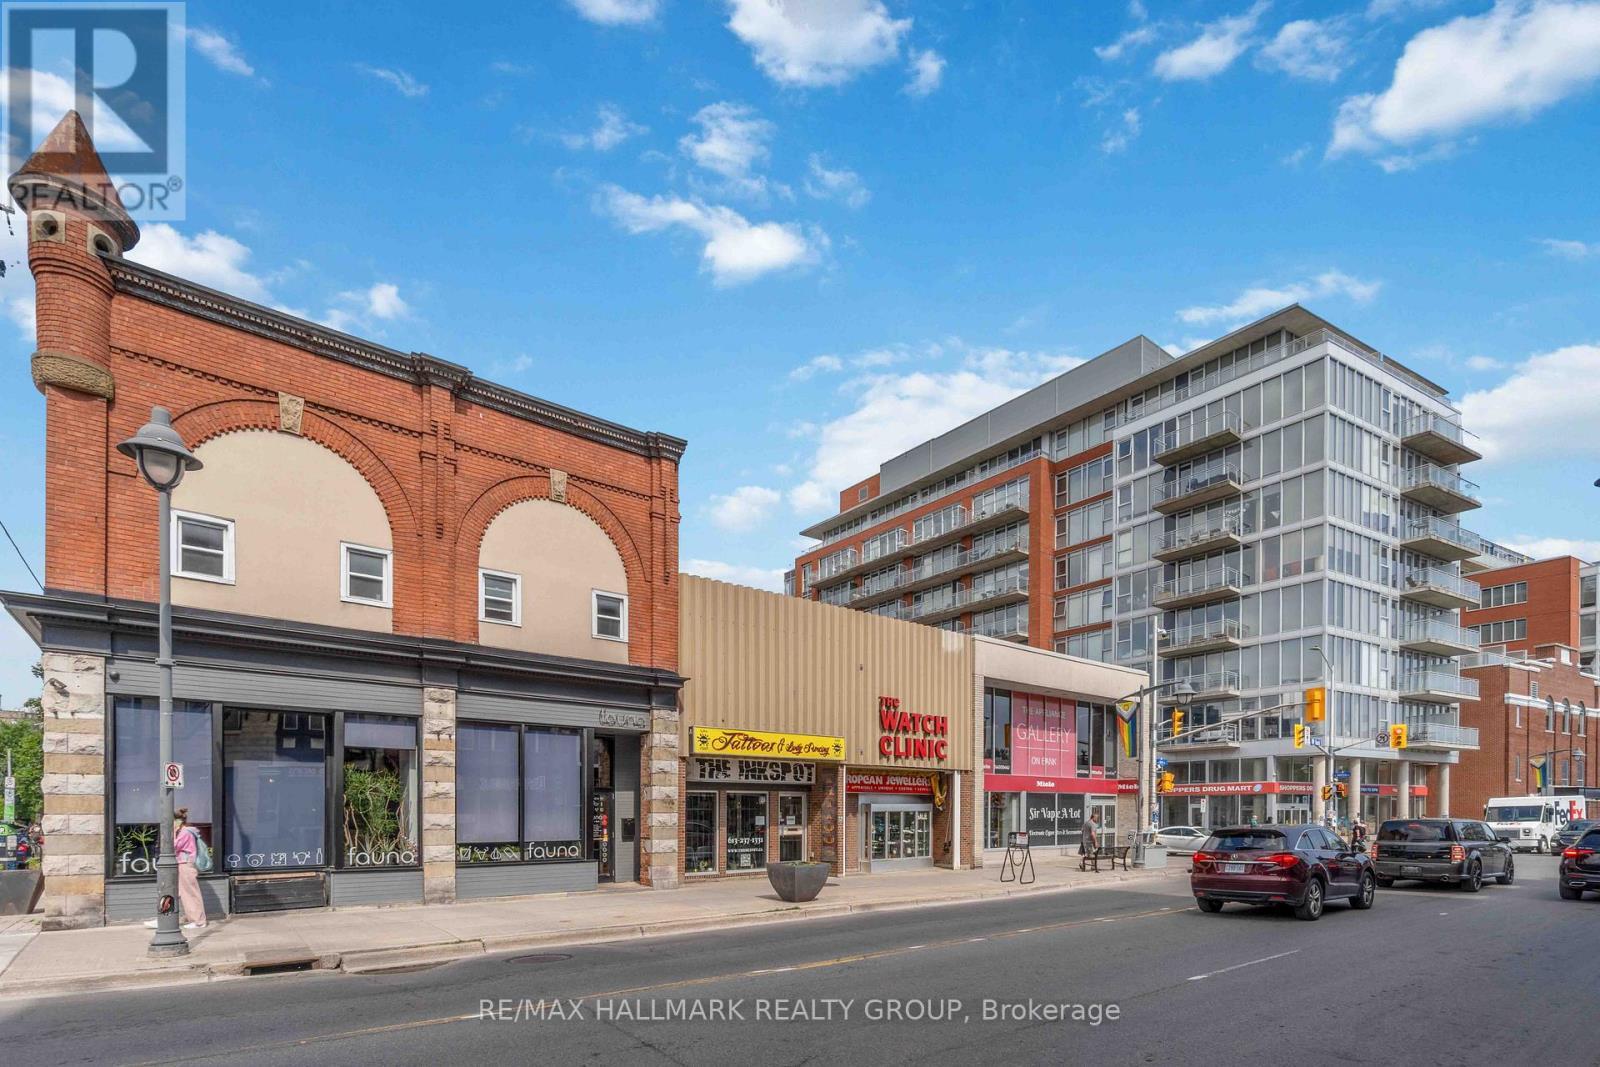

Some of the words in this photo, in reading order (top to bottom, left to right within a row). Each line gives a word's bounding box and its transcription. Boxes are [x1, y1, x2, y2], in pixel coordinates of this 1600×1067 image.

[879, 709, 948, 736] WATCH
[712, 731, 777, 752] Tattoos
[1016, 723, 1071, 744] GALLERY
[879, 735, 948, 760] CLINIC
[695, 758, 731, 779] THE
[738, 759, 814, 782] INKSPOT
[1036, 780, 1055, 788] Miele
[1029, 807, 1040, 820] Sir
[1061, 807, 1069, 820] A
[1070, 807, 1082, 819] Lot
[347, 846, 415, 866] fauna
[526, 841, 579, 859] fauna
